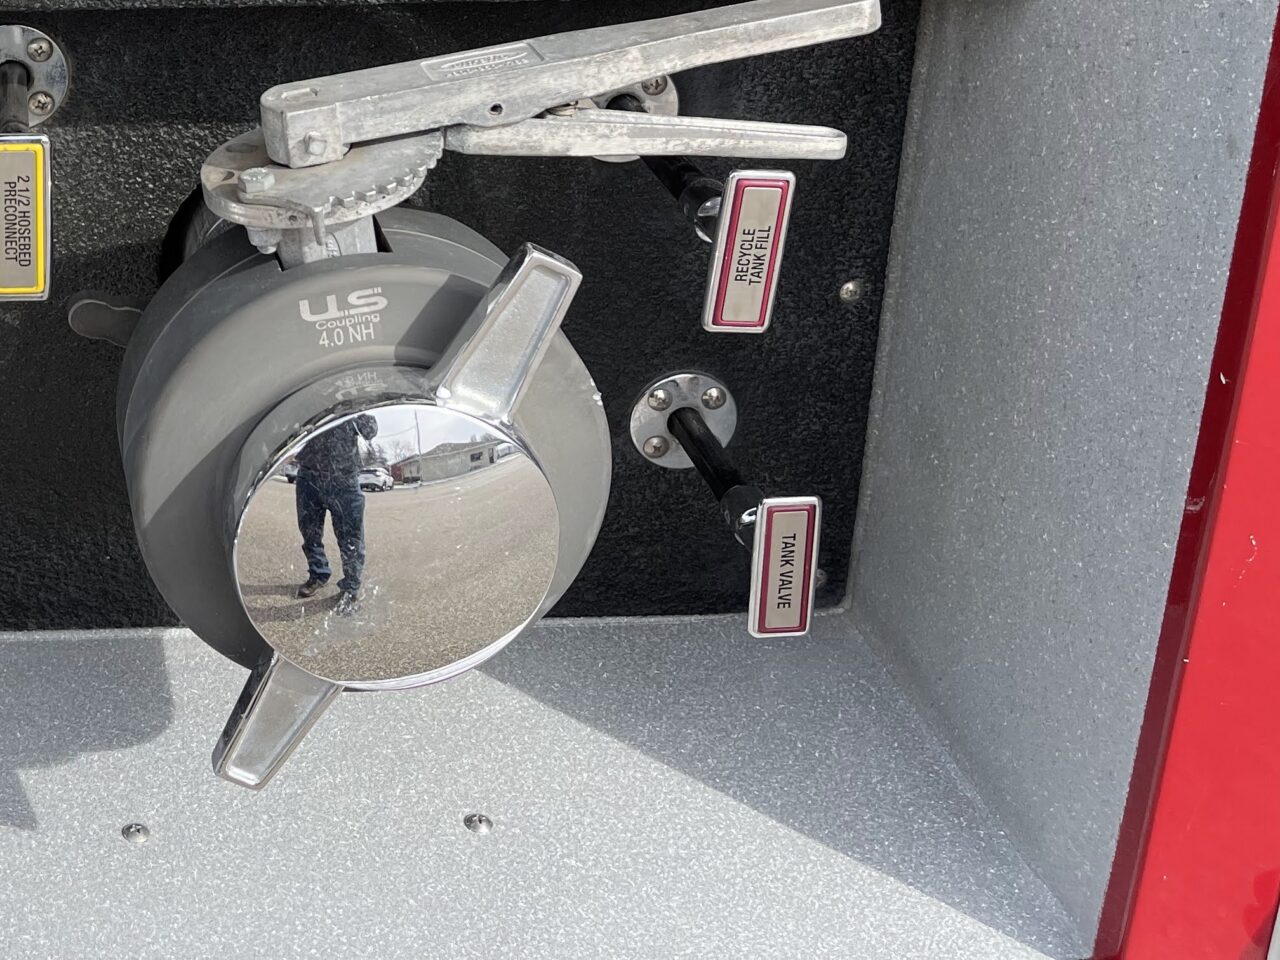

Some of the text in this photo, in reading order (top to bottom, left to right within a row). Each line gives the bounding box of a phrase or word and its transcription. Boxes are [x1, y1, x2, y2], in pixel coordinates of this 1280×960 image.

[4, 181, 17, 262] PRECONNECT
[18, 189, 30, 206] 1/2
[18, 211, 31, 267] HOSEBED
[735, 228, 755, 281] RECYCLE
[749, 226, 771, 285] TANK FILL
[316, 312, 380, 330] Coupling
[319, 323, 375, 349] 4.0 NH
[777, 533, 796, 609] TANK VALVE
